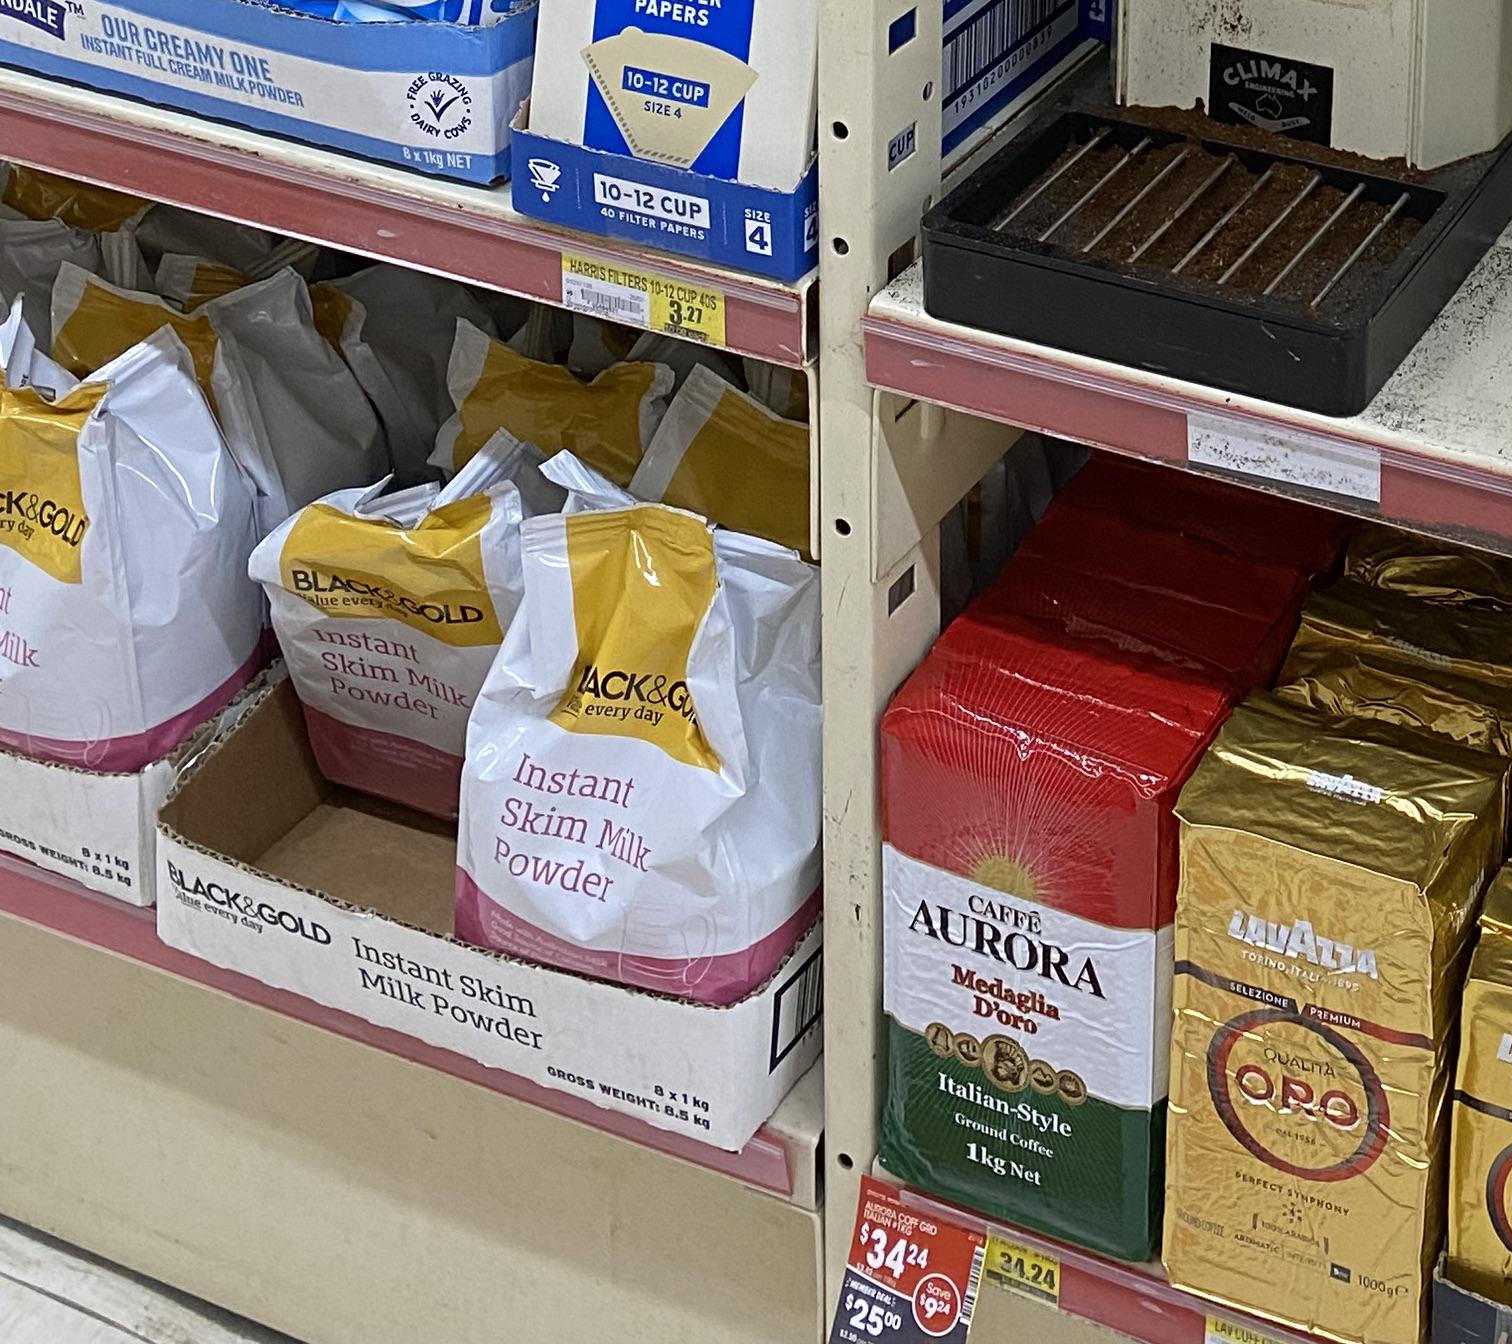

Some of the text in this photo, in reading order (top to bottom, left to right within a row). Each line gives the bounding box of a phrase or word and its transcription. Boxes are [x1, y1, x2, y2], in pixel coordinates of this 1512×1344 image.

[81, 34, 304, 109] INSTANT FULL CREAM MILK POWDER
[101, 15, 273, 82] OUR CREAMY ONE
[626, 70, 706, 102] 10-12 CUP
[1222, 58, 1319, 103] CLIMAX
[669, 300, 703, 325] 3.27
[512, 753, 635, 808] Instant
[500, 797, 654, 872] Skim Milk
[494, 836, 615, 903] Powder
[908, 898, 1107, 1000] AURORA
[951, 964, 1061, 1021] Medaglia
[546, 1065, 597, 1091] GROSS
[664, 1104, 690, 1124] 8.5
[692, 1110, 711, 1131] kg
[938, 1072, 1073, 1138] Italian-Style
[954, 1113, 1055, 1158] Ground Coffee
[965, 1142, 1042, 1186] 1kg Net
